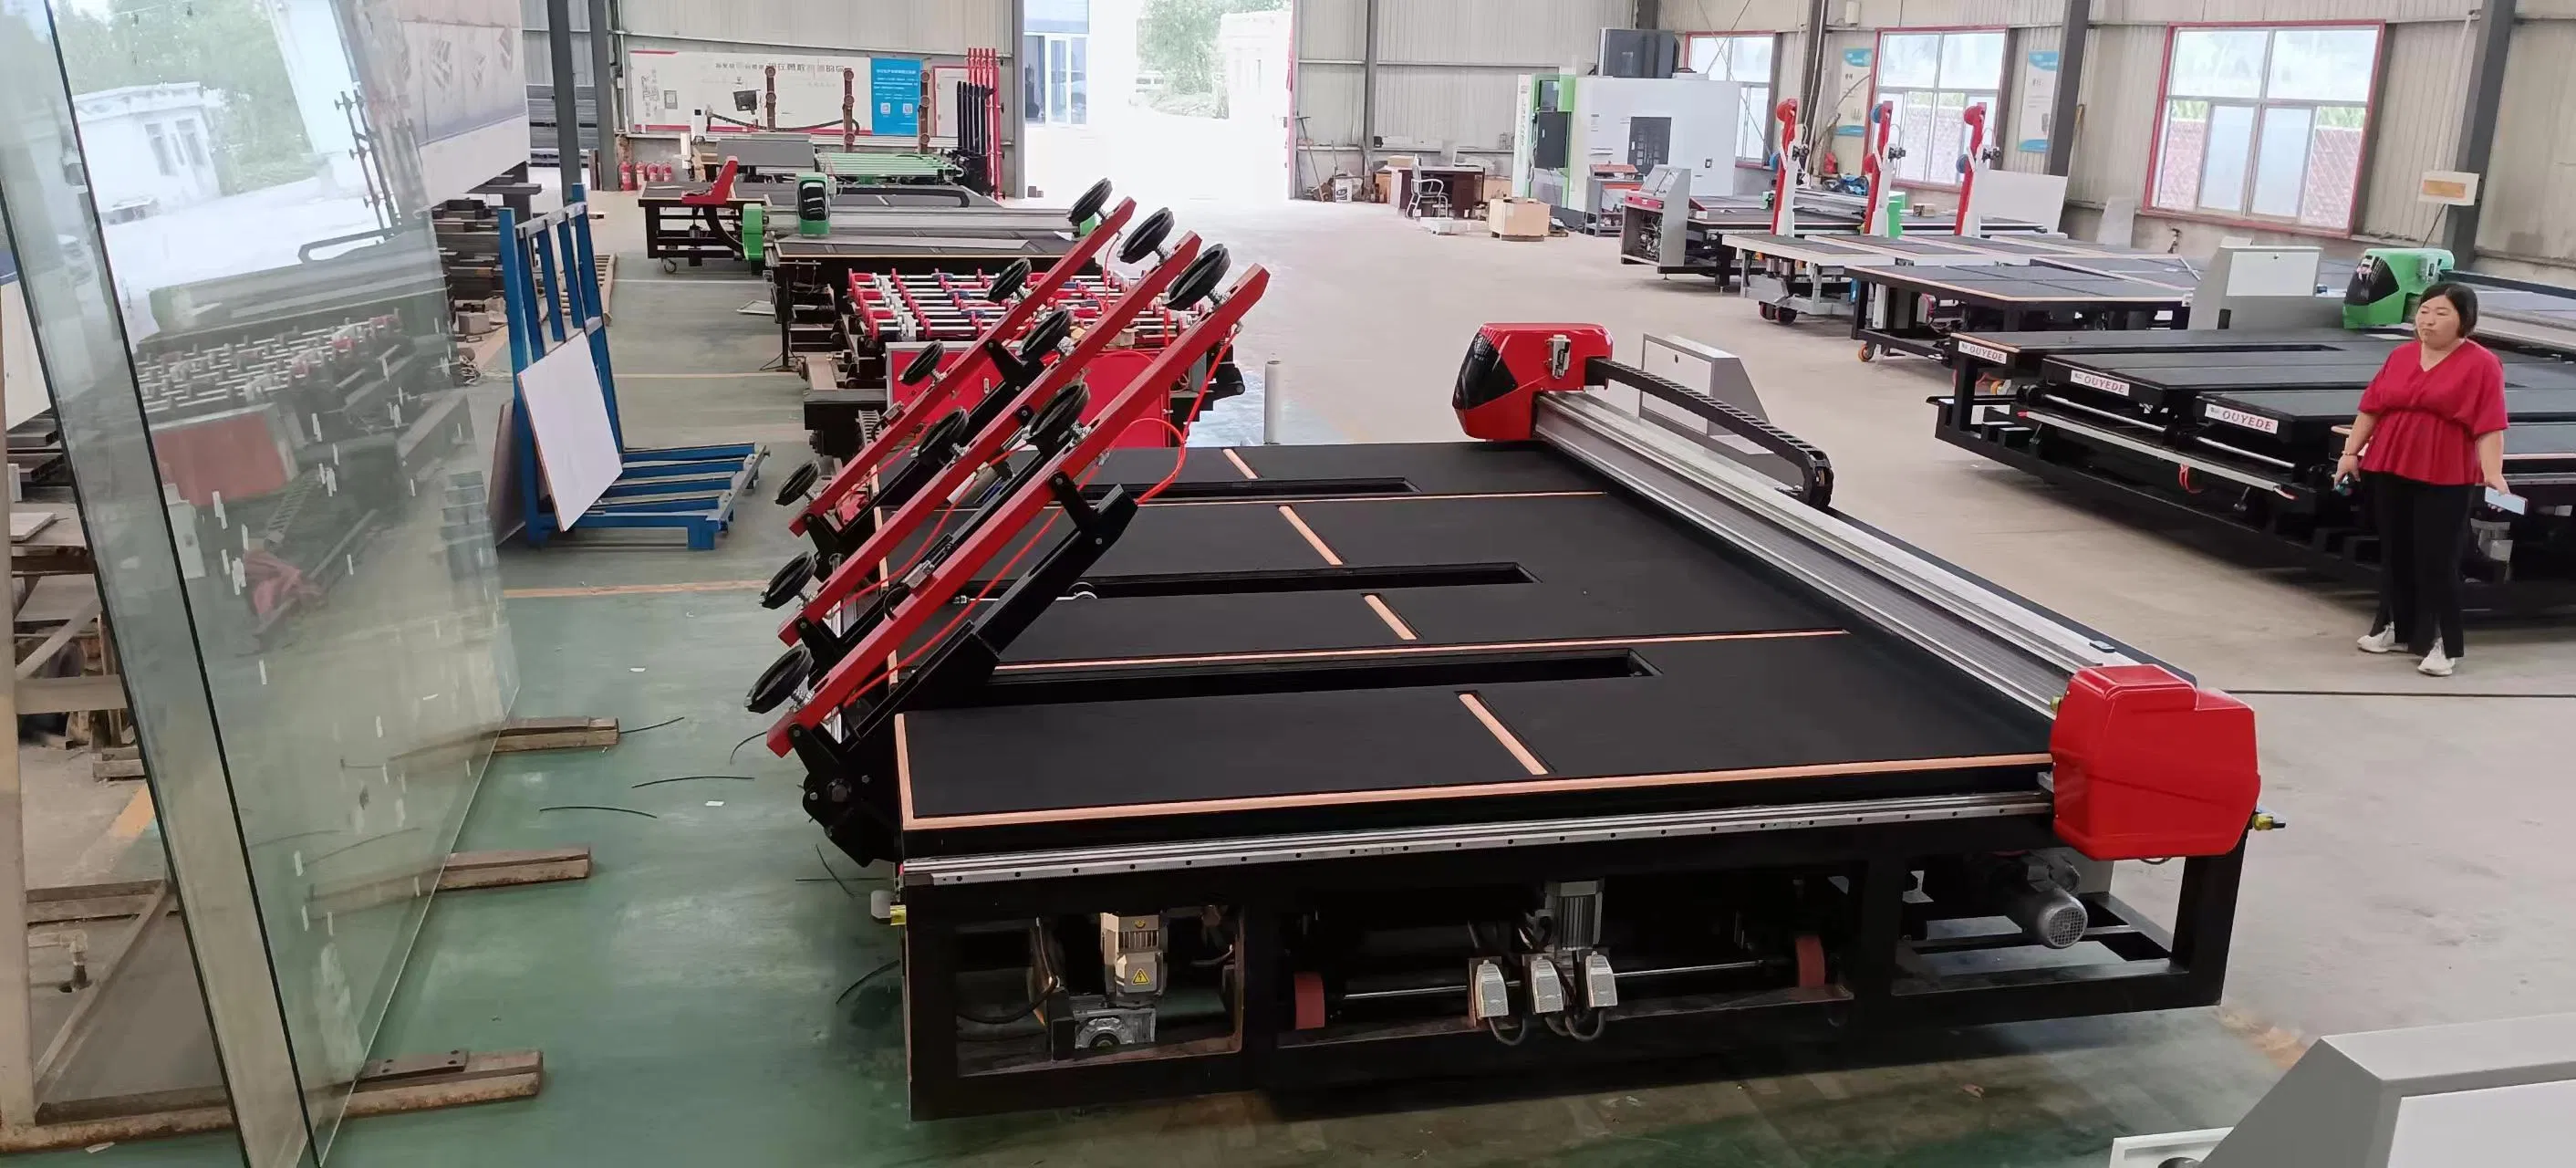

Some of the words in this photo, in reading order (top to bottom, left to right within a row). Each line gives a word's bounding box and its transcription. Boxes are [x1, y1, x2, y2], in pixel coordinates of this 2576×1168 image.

[1969, 345, 2004, 361] OUYEDE
[2084, 375, 2125, 393] OUYEDE
[2222, 410, 2274, 431] OUYEDE
